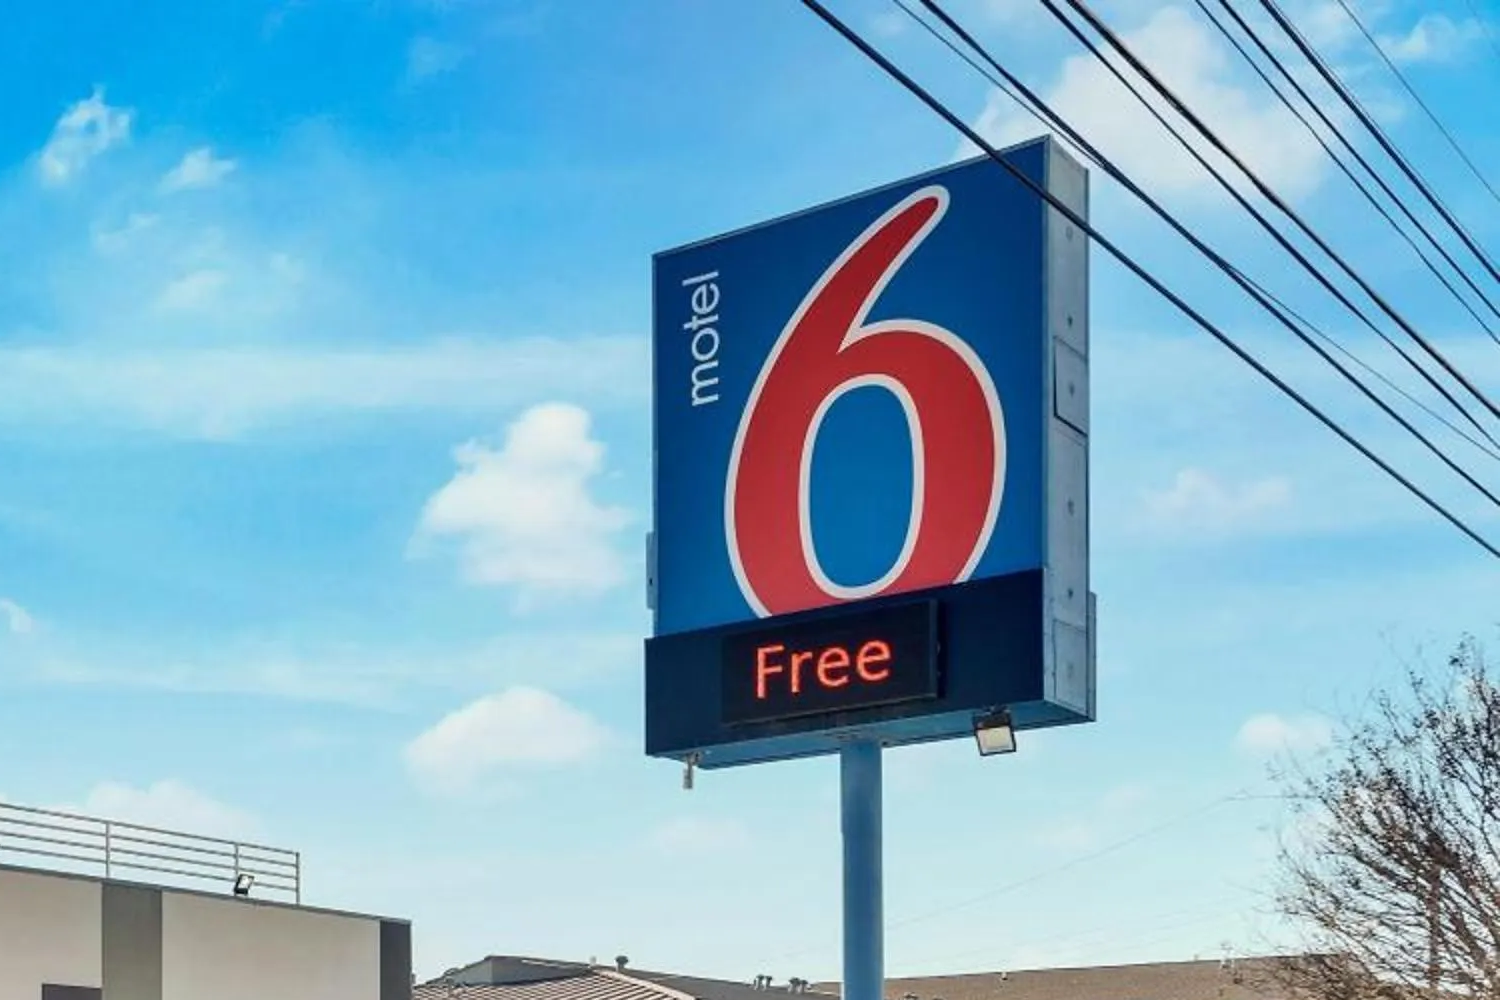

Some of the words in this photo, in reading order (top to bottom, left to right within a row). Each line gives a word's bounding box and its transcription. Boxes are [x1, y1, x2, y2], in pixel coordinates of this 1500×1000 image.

[682, 270, 719, 406] motel
[724, 184, 1007, 619] 6
[755, 639, 892, 698] Free
